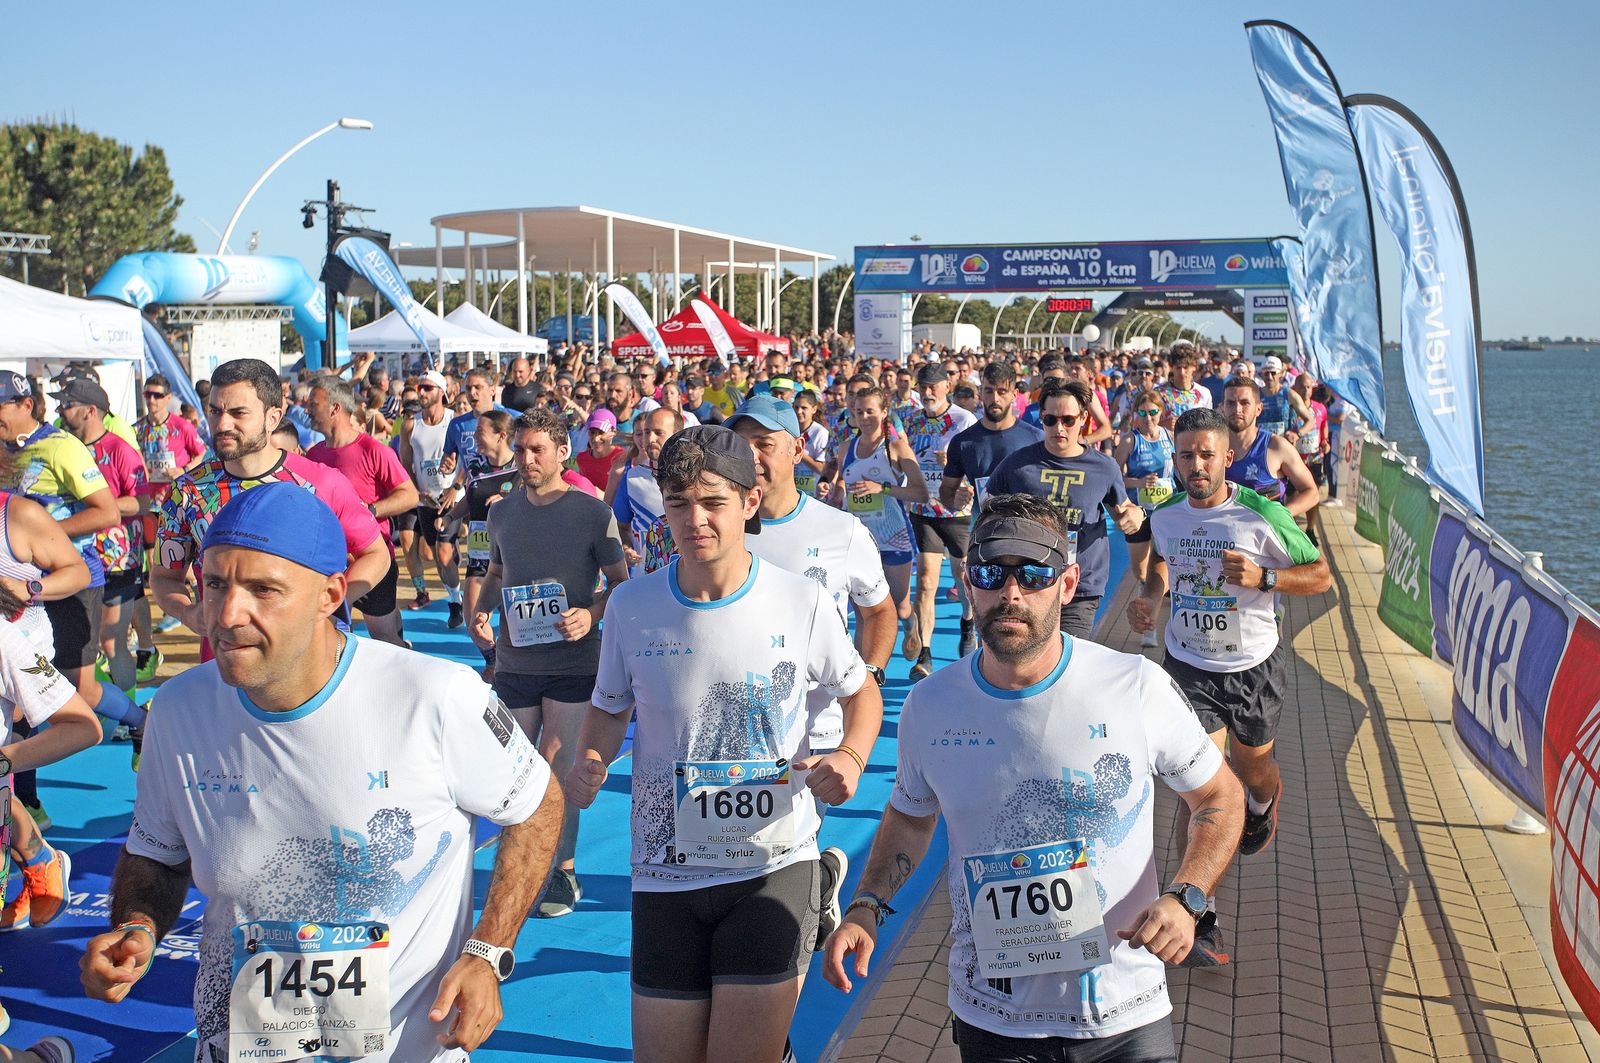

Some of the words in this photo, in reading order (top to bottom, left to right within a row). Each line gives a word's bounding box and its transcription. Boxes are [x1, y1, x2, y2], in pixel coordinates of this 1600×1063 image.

[1002, 247, 1102, 261] CAMPEONATO
[1002, 264, 1018, 277] de
[1020, 262, 1071, 276] ESPAÑA
[1078, 261, 1101, 277] 10
[1106, 259, 1137, 276] km
[1175, 255, 1217, 269] HUELVA
[1067, 277, 1101, 285] Absoluto
[1101, 278, 1108, 286] y
[924, 472, 943, 481] 344
[1144, 487, 1168, 497] 1260
[1180, 538, 1202, 548] GRAN
[1205, 539, 1236, 550] FONDO
[543, 586, 560, 596] 2023
[515, 599, 560, 619] 1716
[1211, 600, 1228, 609] 202
[1181, 610, 1228, 631] 1106
[635, 647, 693, 658] JORMA
[930, 737, 996, 747] JORMA
[202, 769, 244, 780] Muebles
[699, 768, 725, 779] HUELVA
[751, 767, 780, 780] 2023
[183, 780, 260, 793] JORMA
[694, 789, 774, 819] 1680
[721, 825, 747, 833] LUCAS
[707, 835, 726, 843] RUIZ
[726, 835, 761, 843] BAUTISTA
[687, 852, 719, 860] HYUNDAI
[725, 848, 755, 859] Syrluz
[984, 860, 1009, 874] HUELVA
[1037, 849, 1075, 870] 2023
[985, 877, 1073, 921] 1760
[995, 924, 1042, 937] FRANCISCO
[1042, 919, 1073, 931] JAVIER
[263, 928, 294, 942] HUELVA
[332, 925, 371, 945] 202
[1000, 939, 1023, 948] SERA
[1023, 931, 1071, 945] DANCAUCE
[300, 942, 321, 950] WiHu
[1027, 950, 1062, 964] Syrluz
[988, 960, 1022, 970] HYUNDAI
[255, 956, 367, 998] 1454
[293, 1005, 326, 1016] DIEGO
[262, 1020, 315, 1031] PALACIOS
[317, 1018, 356, 1029] LANZAS
[239, 1048, 287, 1058] HYUNDAI
